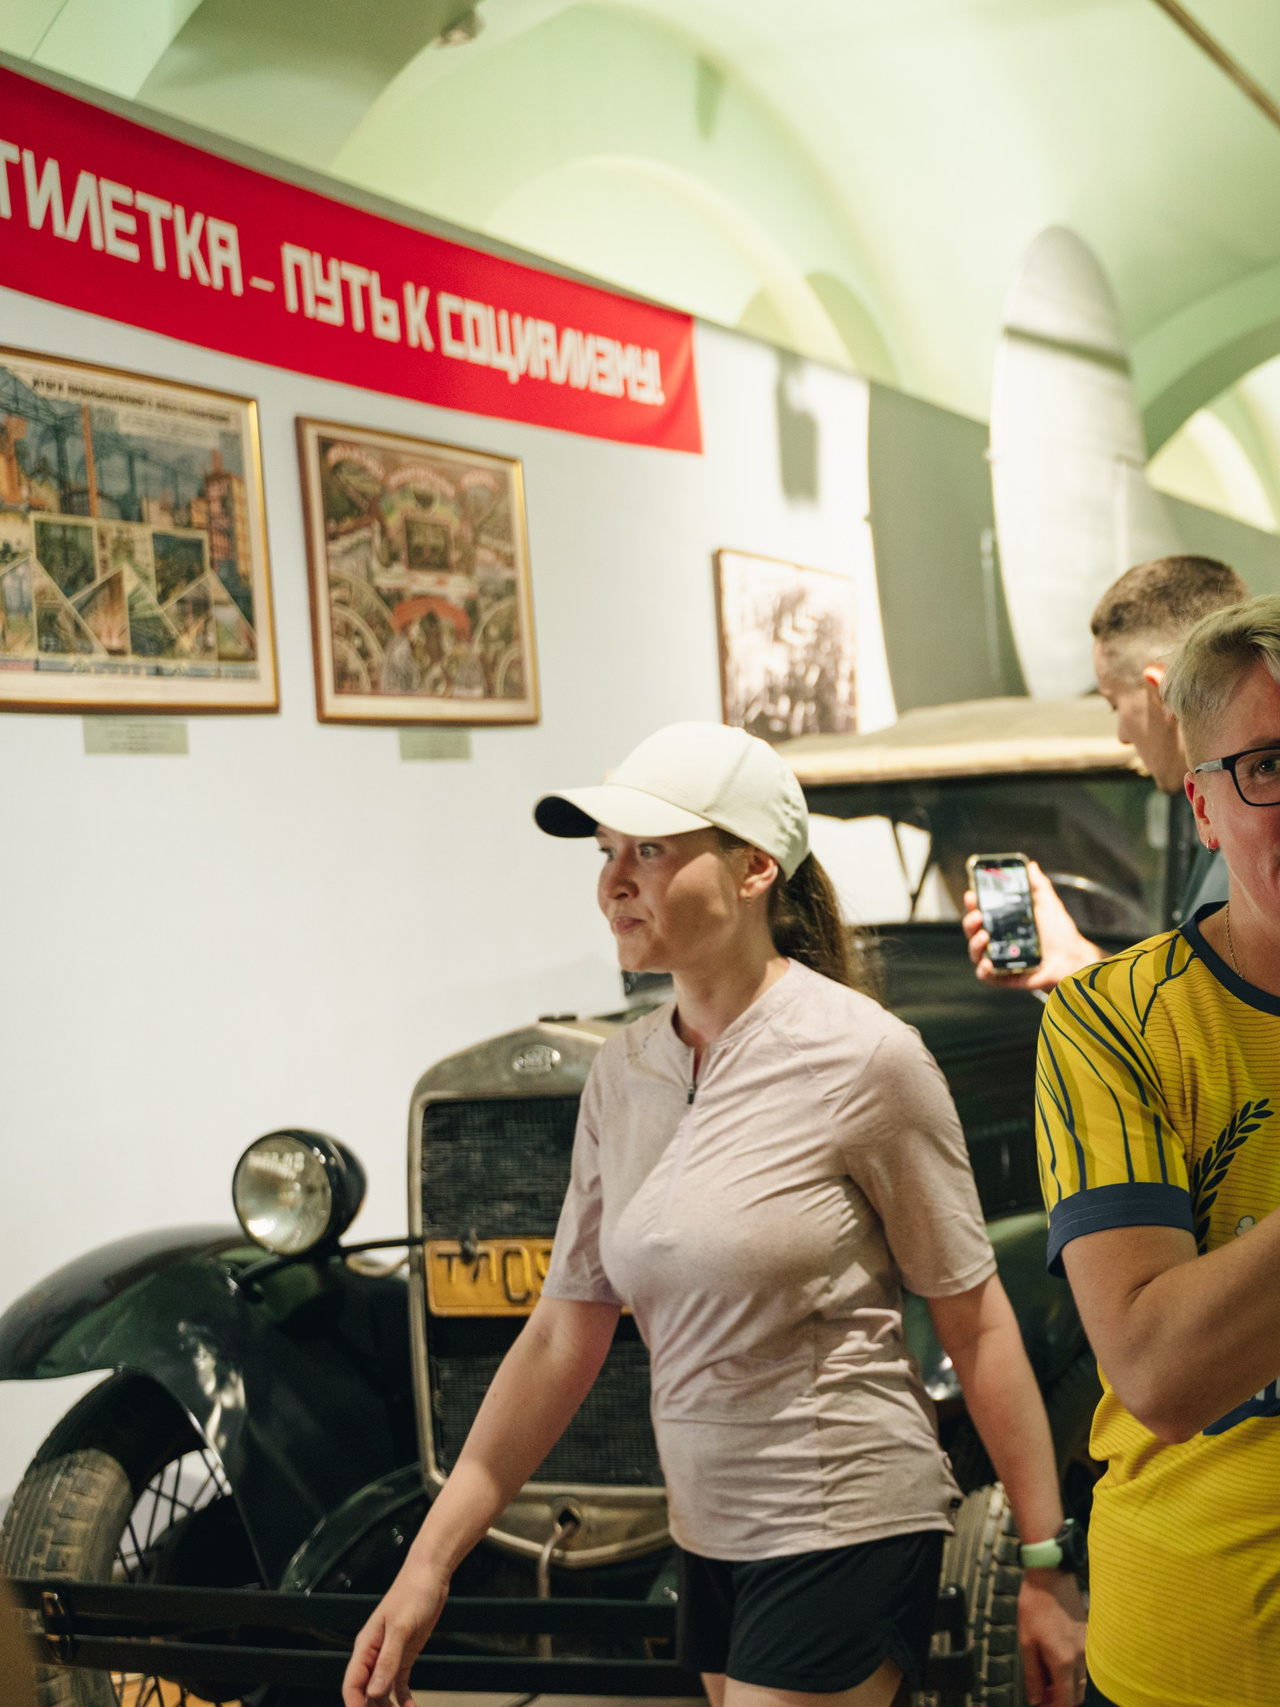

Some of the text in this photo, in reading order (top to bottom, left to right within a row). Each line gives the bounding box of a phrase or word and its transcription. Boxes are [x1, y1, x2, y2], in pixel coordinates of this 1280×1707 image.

[281, 241, 401, 342] ПУТЬ
[403, 281, 435, 352] К
[437, 290, 666, 406] СОЦИАЛИЗМУ!
